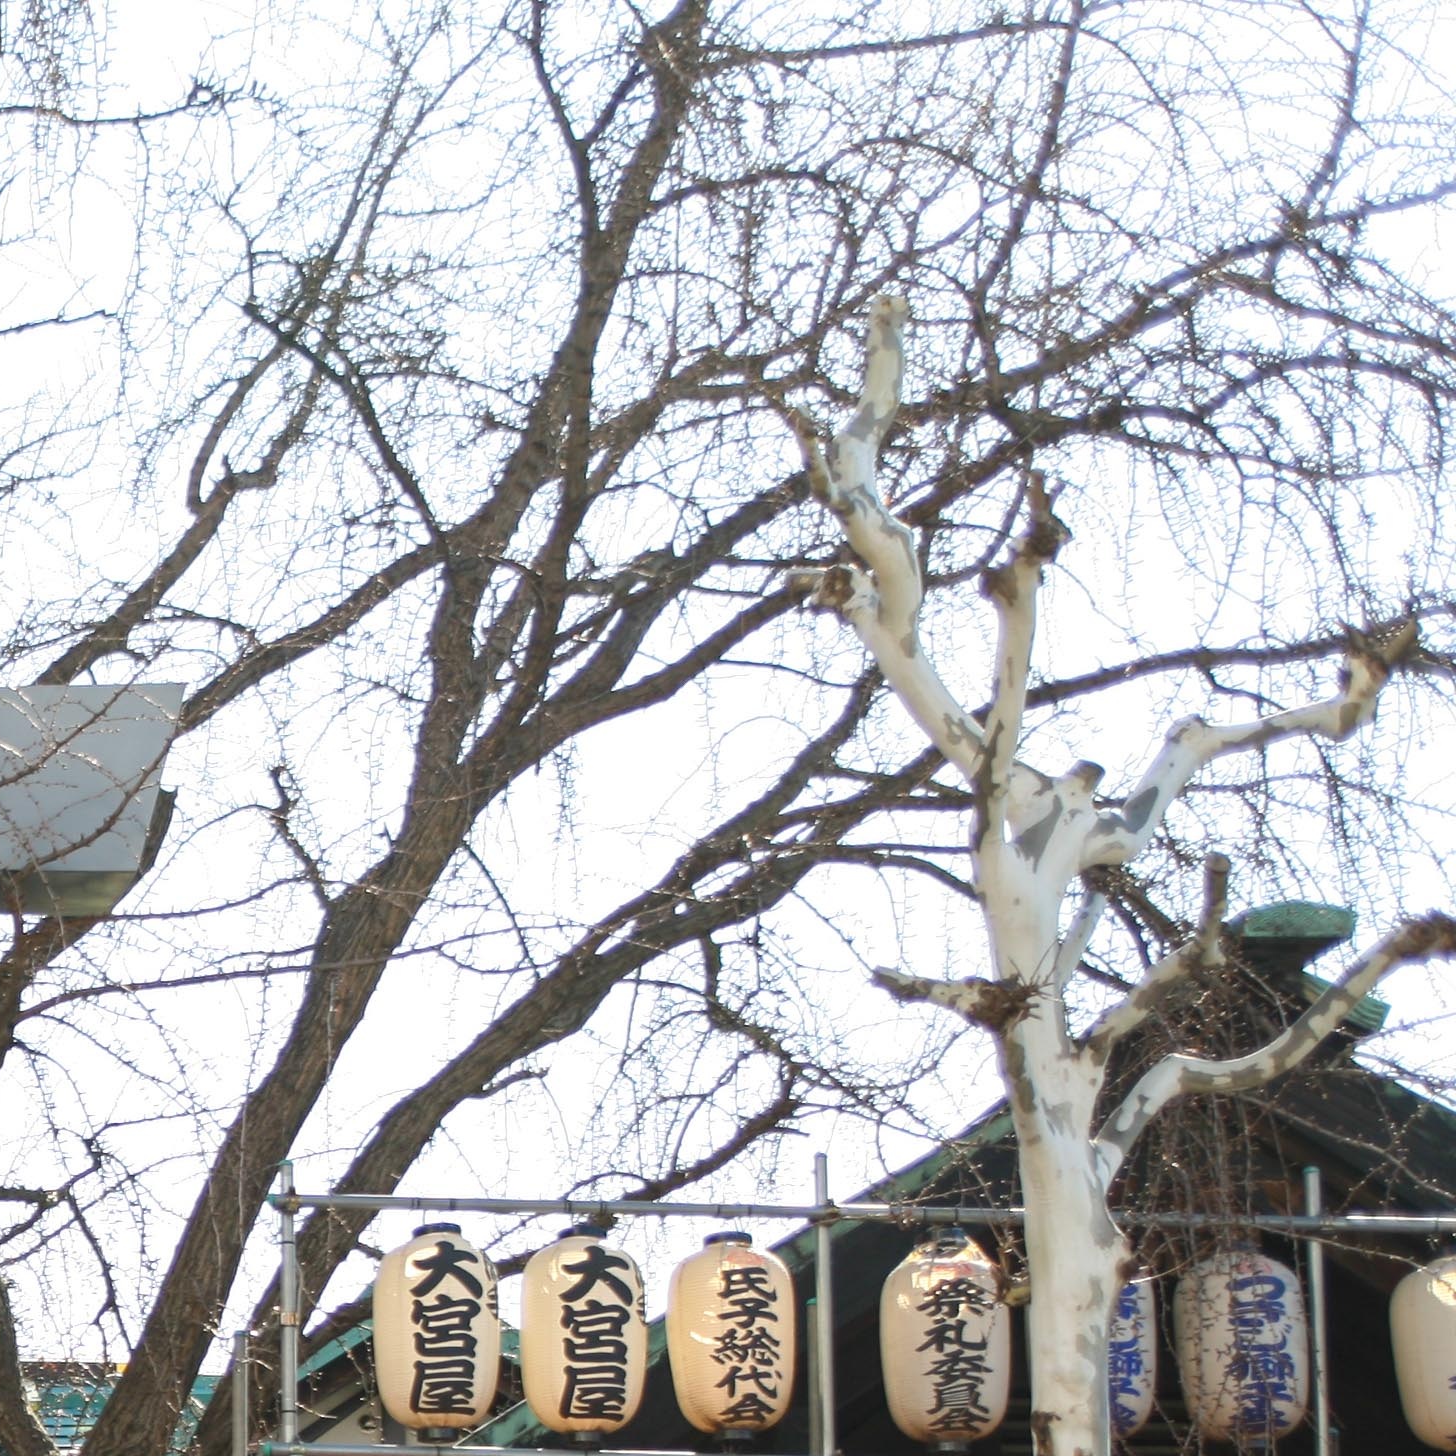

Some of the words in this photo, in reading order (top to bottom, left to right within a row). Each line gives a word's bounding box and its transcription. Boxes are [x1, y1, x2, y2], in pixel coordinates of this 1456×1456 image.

[409, 1241, 484, 1416] 大宮屋
[558, 1246, 634, 1422] 大宮屋
[710, 1266, 783, 1425] 氏子総代会
[915, 1278, 995, 1436] 祭礼委員会
